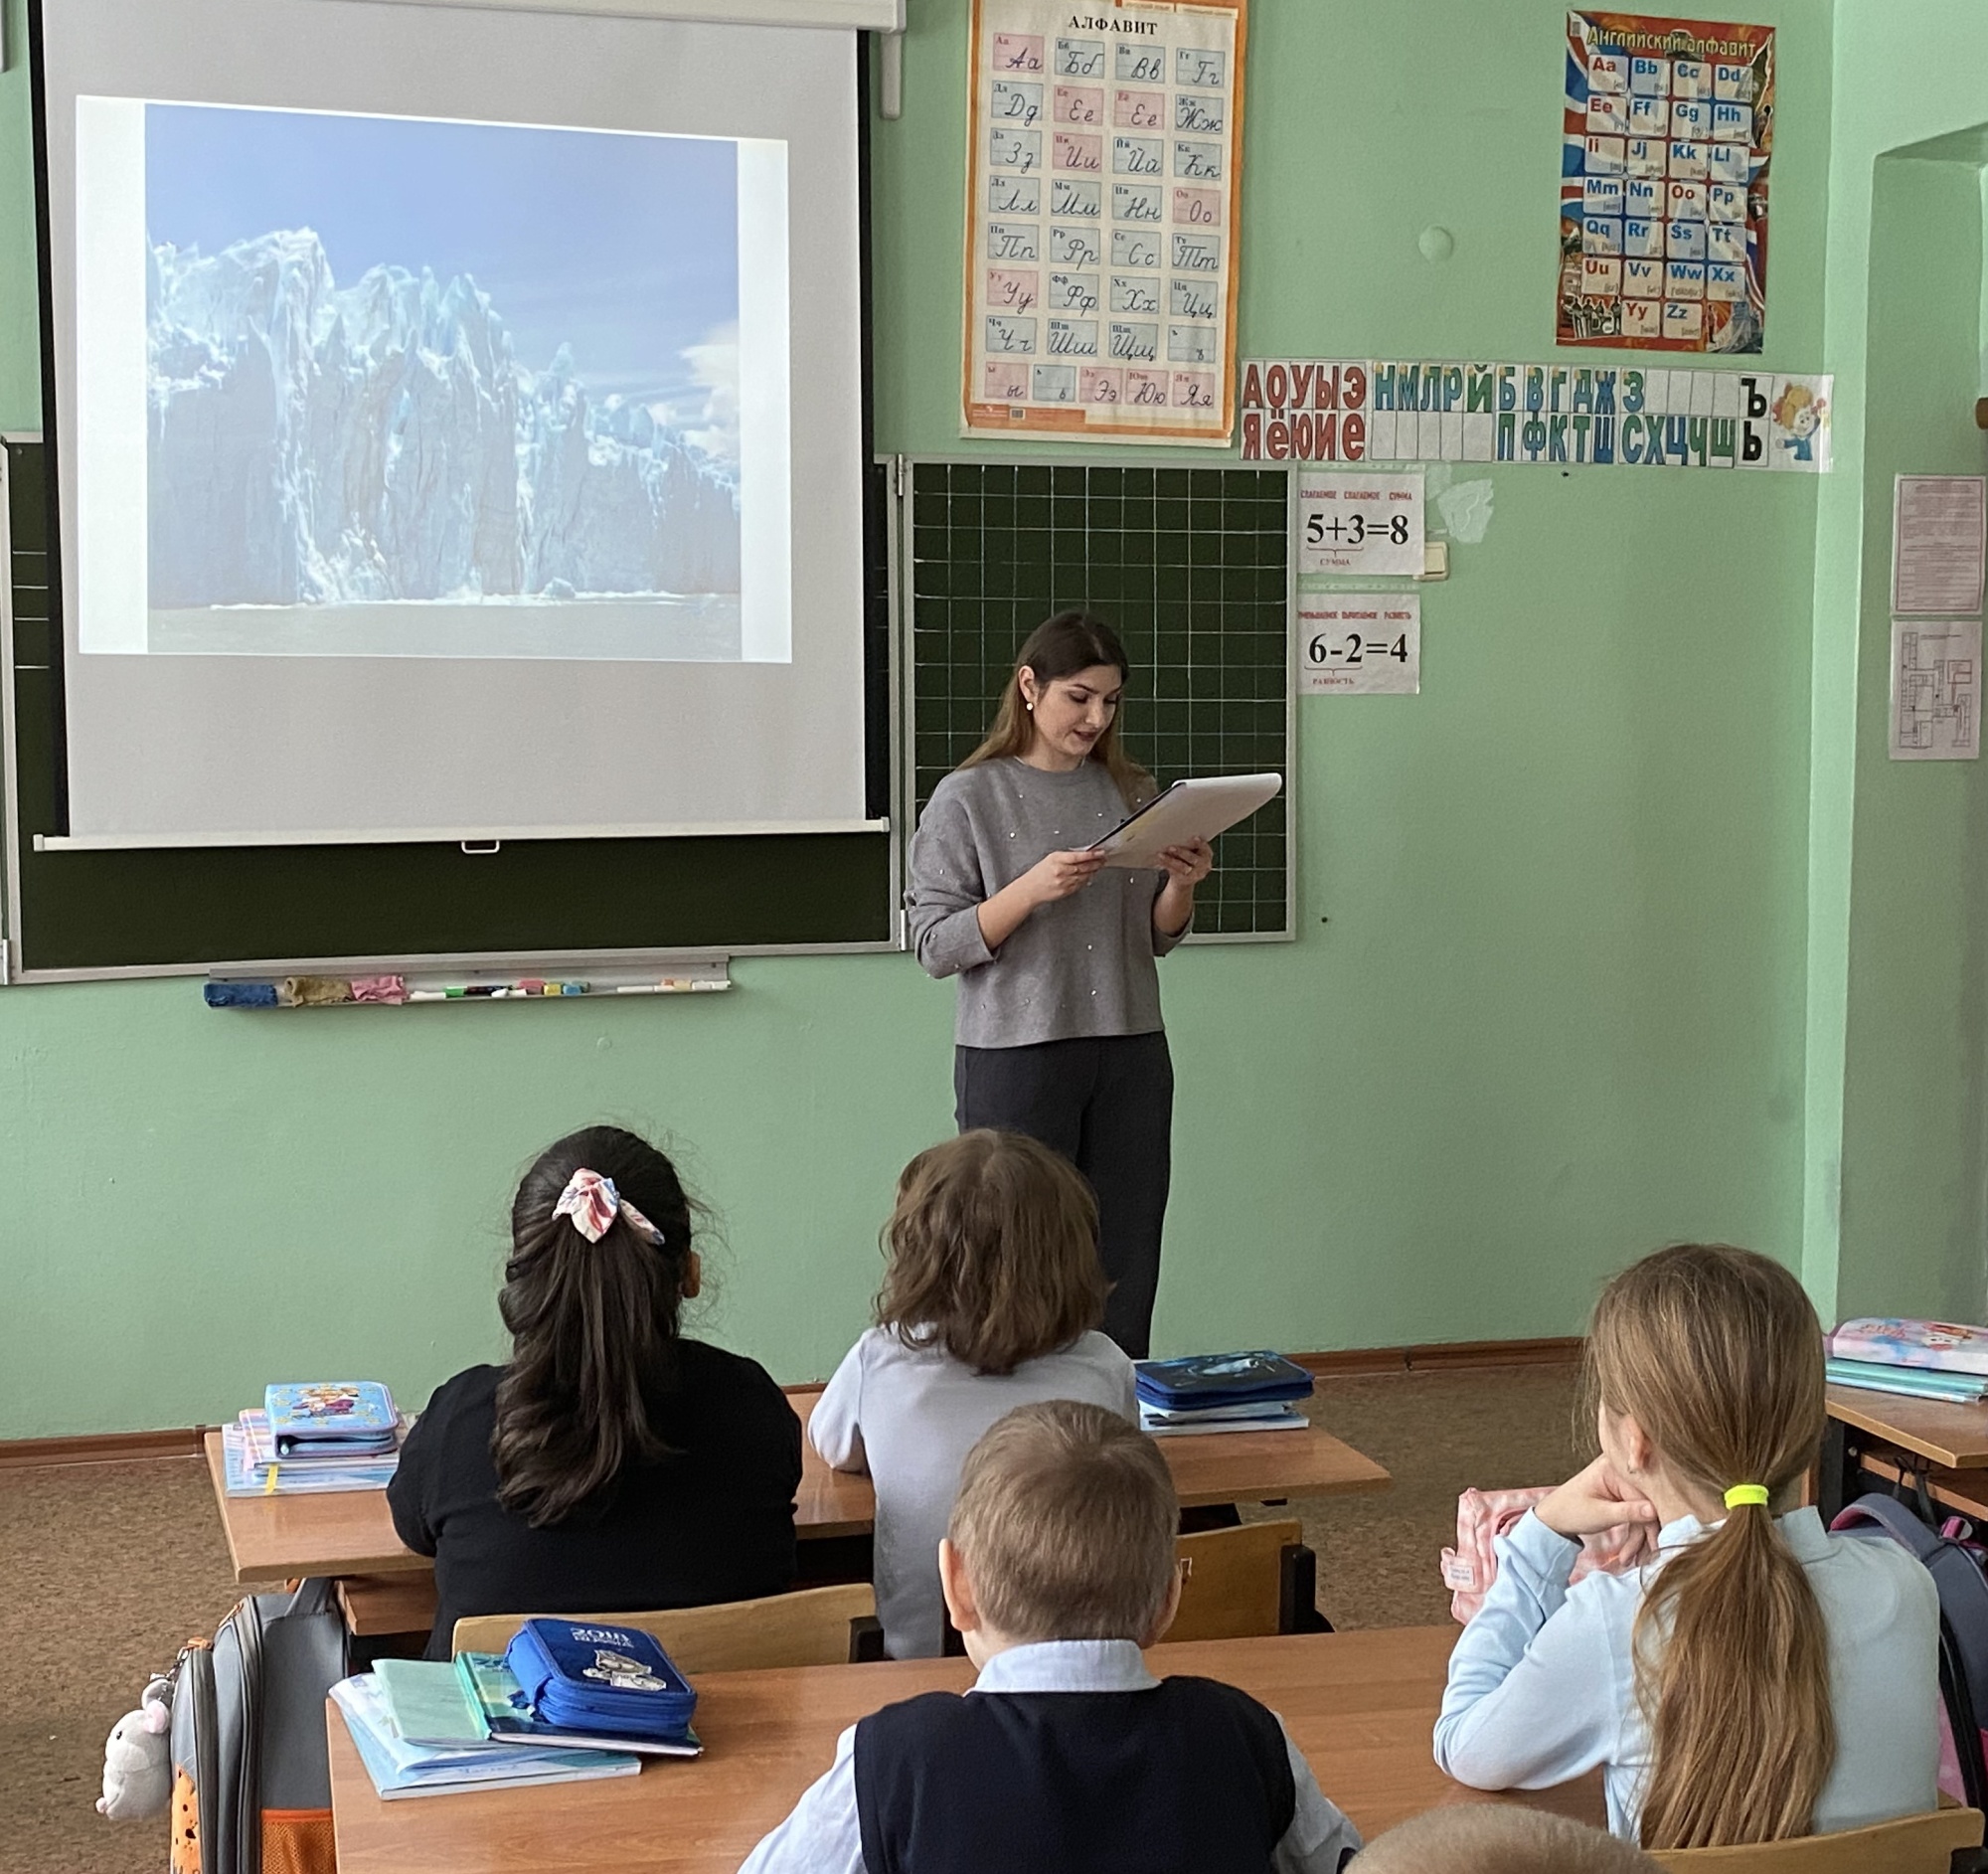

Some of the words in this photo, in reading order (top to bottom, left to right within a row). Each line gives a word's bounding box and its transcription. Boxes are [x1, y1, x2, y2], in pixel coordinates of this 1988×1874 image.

[1068, 15, 1158, 36] АЛФАВИТ
[1587, 26, 1682, 51] Английский
[1687, 37, 1756, 57] алфавит
[1006, 48, 1043, 71] Аа
[1065, 52, 1103, 75] Бб
[1131, 58, 1160, 80] Вв
[1192, 61, 1220, 85] Гг
[1592, 58, 1616, 73] Aa
[1635, 62, 1658, 75] Bb
[1677, 64, 1700, 79] Cc
[1718, 68, 1740, 82] Dd
[1005, 93, 1038, 127] Дд
[1070, 99, 1094, 121] Ее
[1176, 106, 1222, 130] Жж
[1590, 98, 1612, 113] Ee
[1633, 101, 1651, 115] Ff
[1676, 104, 1699, 121] Gg
[1718, 108, 1740, 121] Hh
[1006, 142, 1034, 174] Зз
[1066, 146, 1099, 169] Ии
[1185, 154, 1221, 177] Кк
[1588, 139, 1599, 153] Ii
[1631, 141, 1647, 159] Jj
[1673, 145, 1697, 160] Kk
[1715, 148, 1730, 162] Ll
[999, 189, 1037, 212] Лл
[1051, 193, 1100, 216] Мм
[1125, 197, 1161, 219] Нн
[1190, 201, 1212, 222] Оо
[1586, 180, 1618, 195] Mm
[1630, 183, 1653, 197] Nn
[1672, 185, 1695, 200] Oo
[1714, 189, 1734, 204] Pp
[1586, 221, 1610, 238] Qq
[1628, 225, 1649, 238] Rr
[1671, 226, 1693, 240] Ss
[1713, 229, 1732, 243] Tt
[996, 236, 1036, 258] Пп
[1064, 240, 1097, 270] Рр
[1129, 243, 1155, 264] Сс
[1173, 246, 1218, 270] Тт
[1585, 260, 1609, 274] Uu
[1628, 262, 1651, 277] Vv
[1670, 265, 1702, 279] Ww
[1712, 268, 1735, 282] Xx
[1004, 280, 1034, 314] Уу
[1064, 285, 1096, 316] Фф
[1123, 289, 1156, 311] Хх
[1184, 293, 1214, 318] Цц
[1626, 303, 1648, 320] Yy
[1667, 305, 1688, 319] Zz
[999, 329, 1032, 351] Чч
[1051, 331, 1096, 354] Шш
[1113, 334, 1155, 360] Щщ
[1095, 381, 1116, 402] Ээ
[1134, 383, 1165, 405] Юю
[1182, 384, 1213, 407] Яя
[1622, 370, 1644, 413] З
[1741, 378, 1767, 418] Ъ
[1743, 422, 1762, 461] Ь
[1307, 514, 1408, 545] 5+3=8
[1309, 633, 1408, 663] 6-2=4
